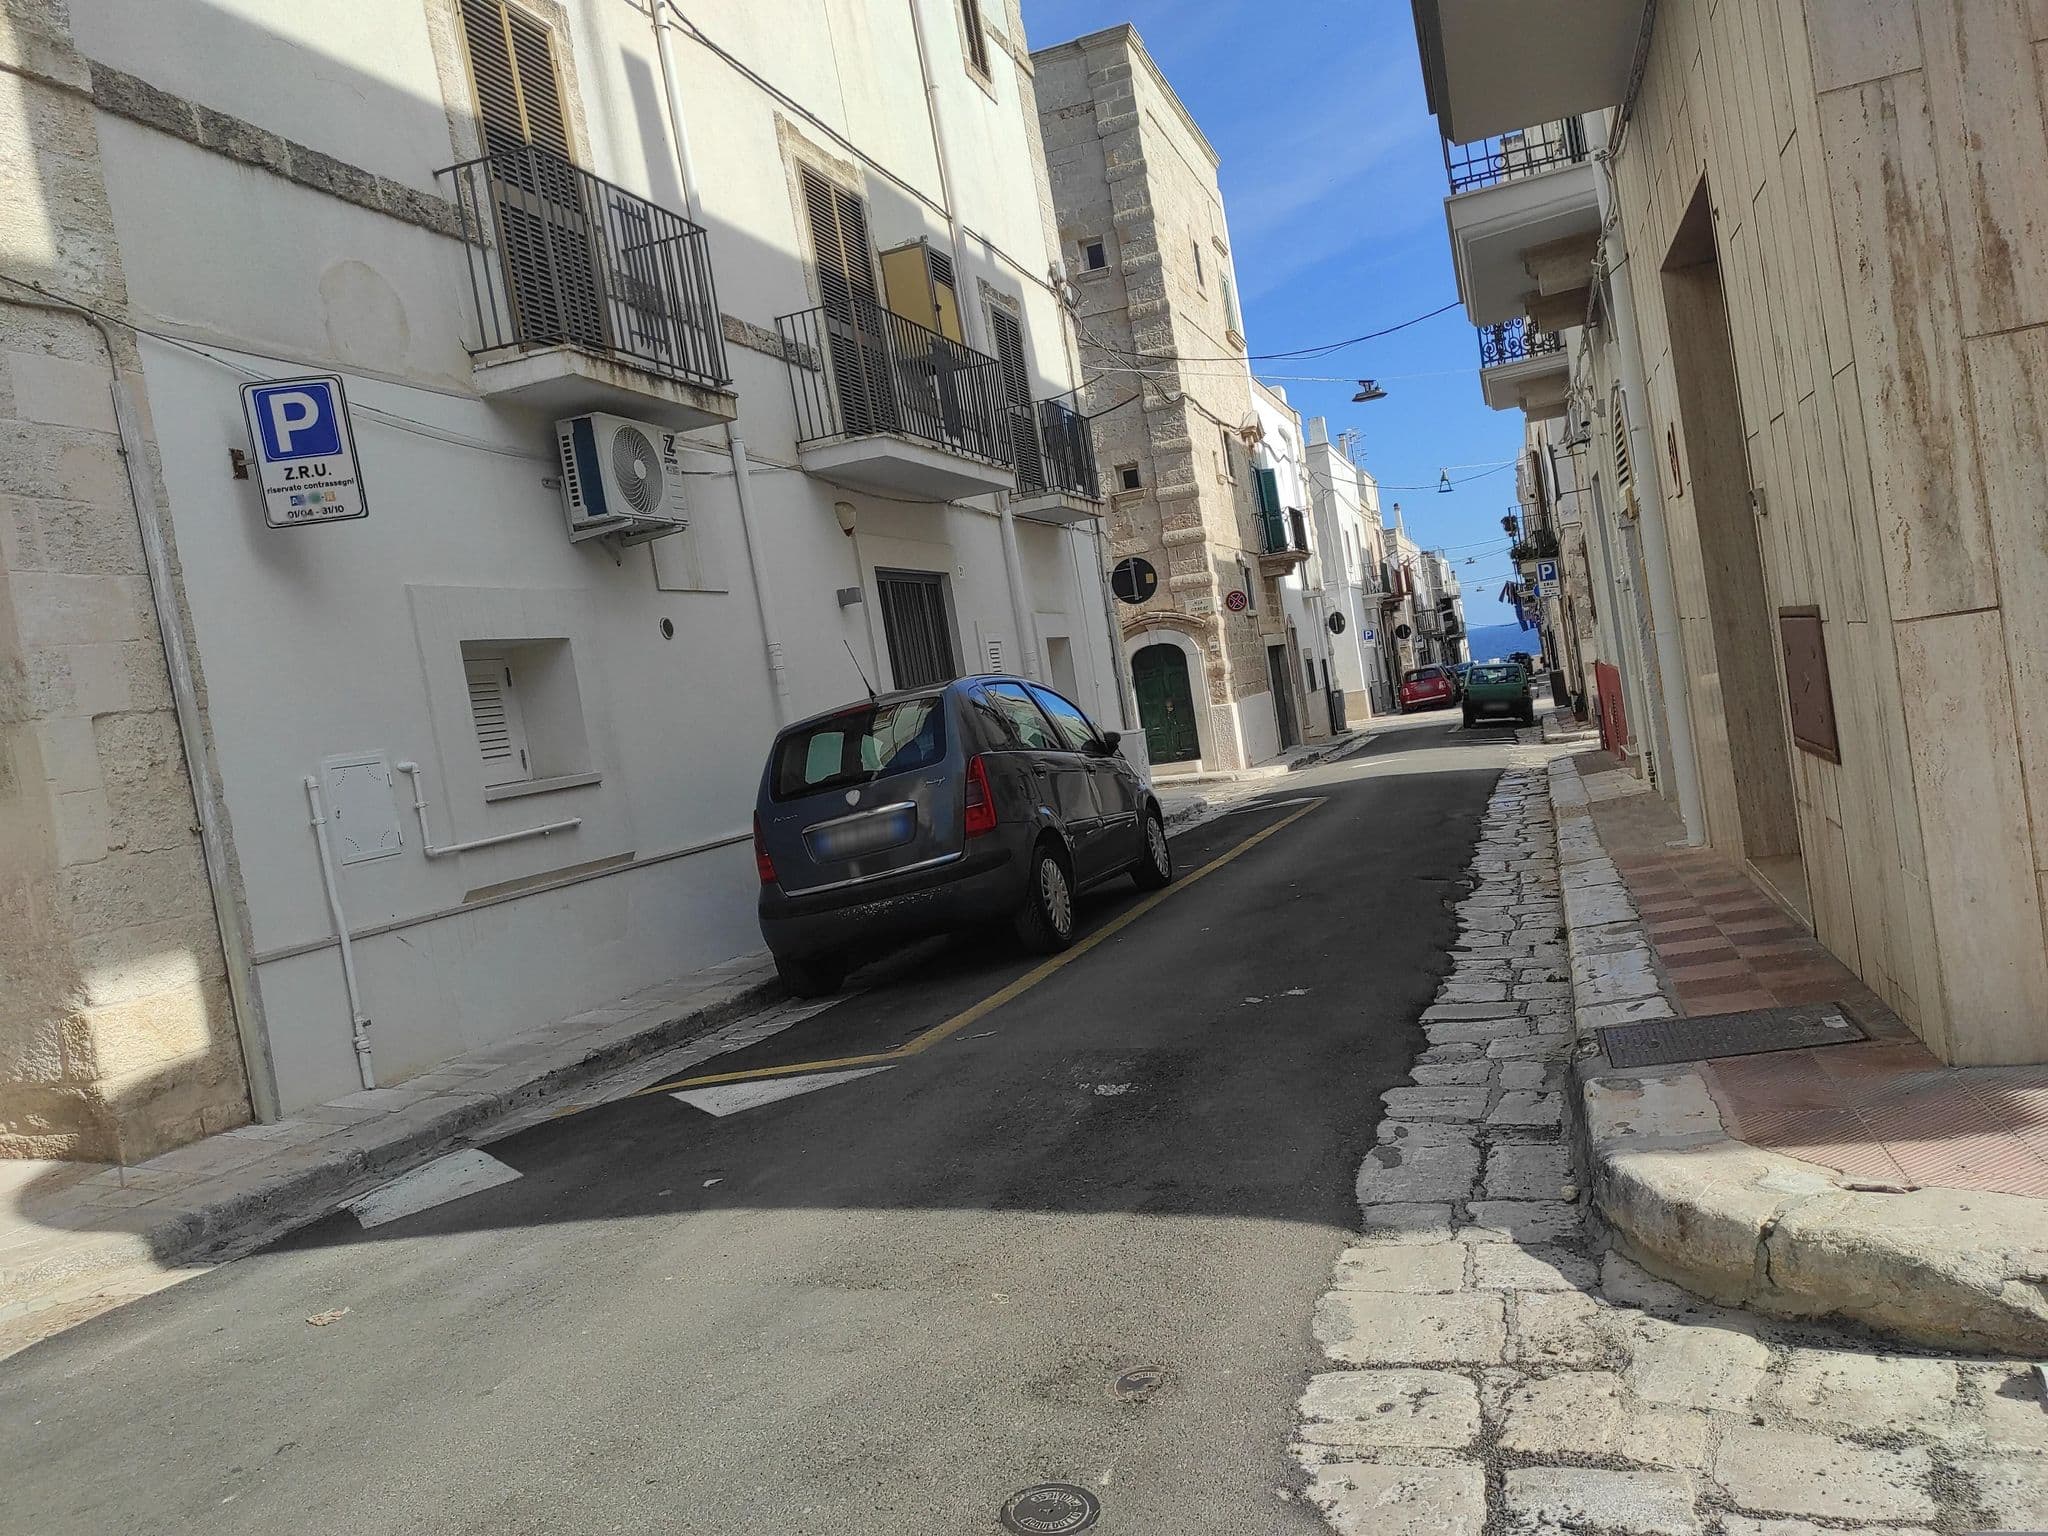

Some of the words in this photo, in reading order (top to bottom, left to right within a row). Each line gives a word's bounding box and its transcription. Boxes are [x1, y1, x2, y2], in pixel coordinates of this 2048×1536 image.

[268, 391, 319, 454] P
[283, 463, 333, 481] Z.R.U.
[266, 484, 302, 495] riservato
[303, 477, 355, 490] contrassegni
[321, 504, 345, 515] 31/10
[1541, 564, 1552, 580] P
[1365, 630, 1373, 640] P
